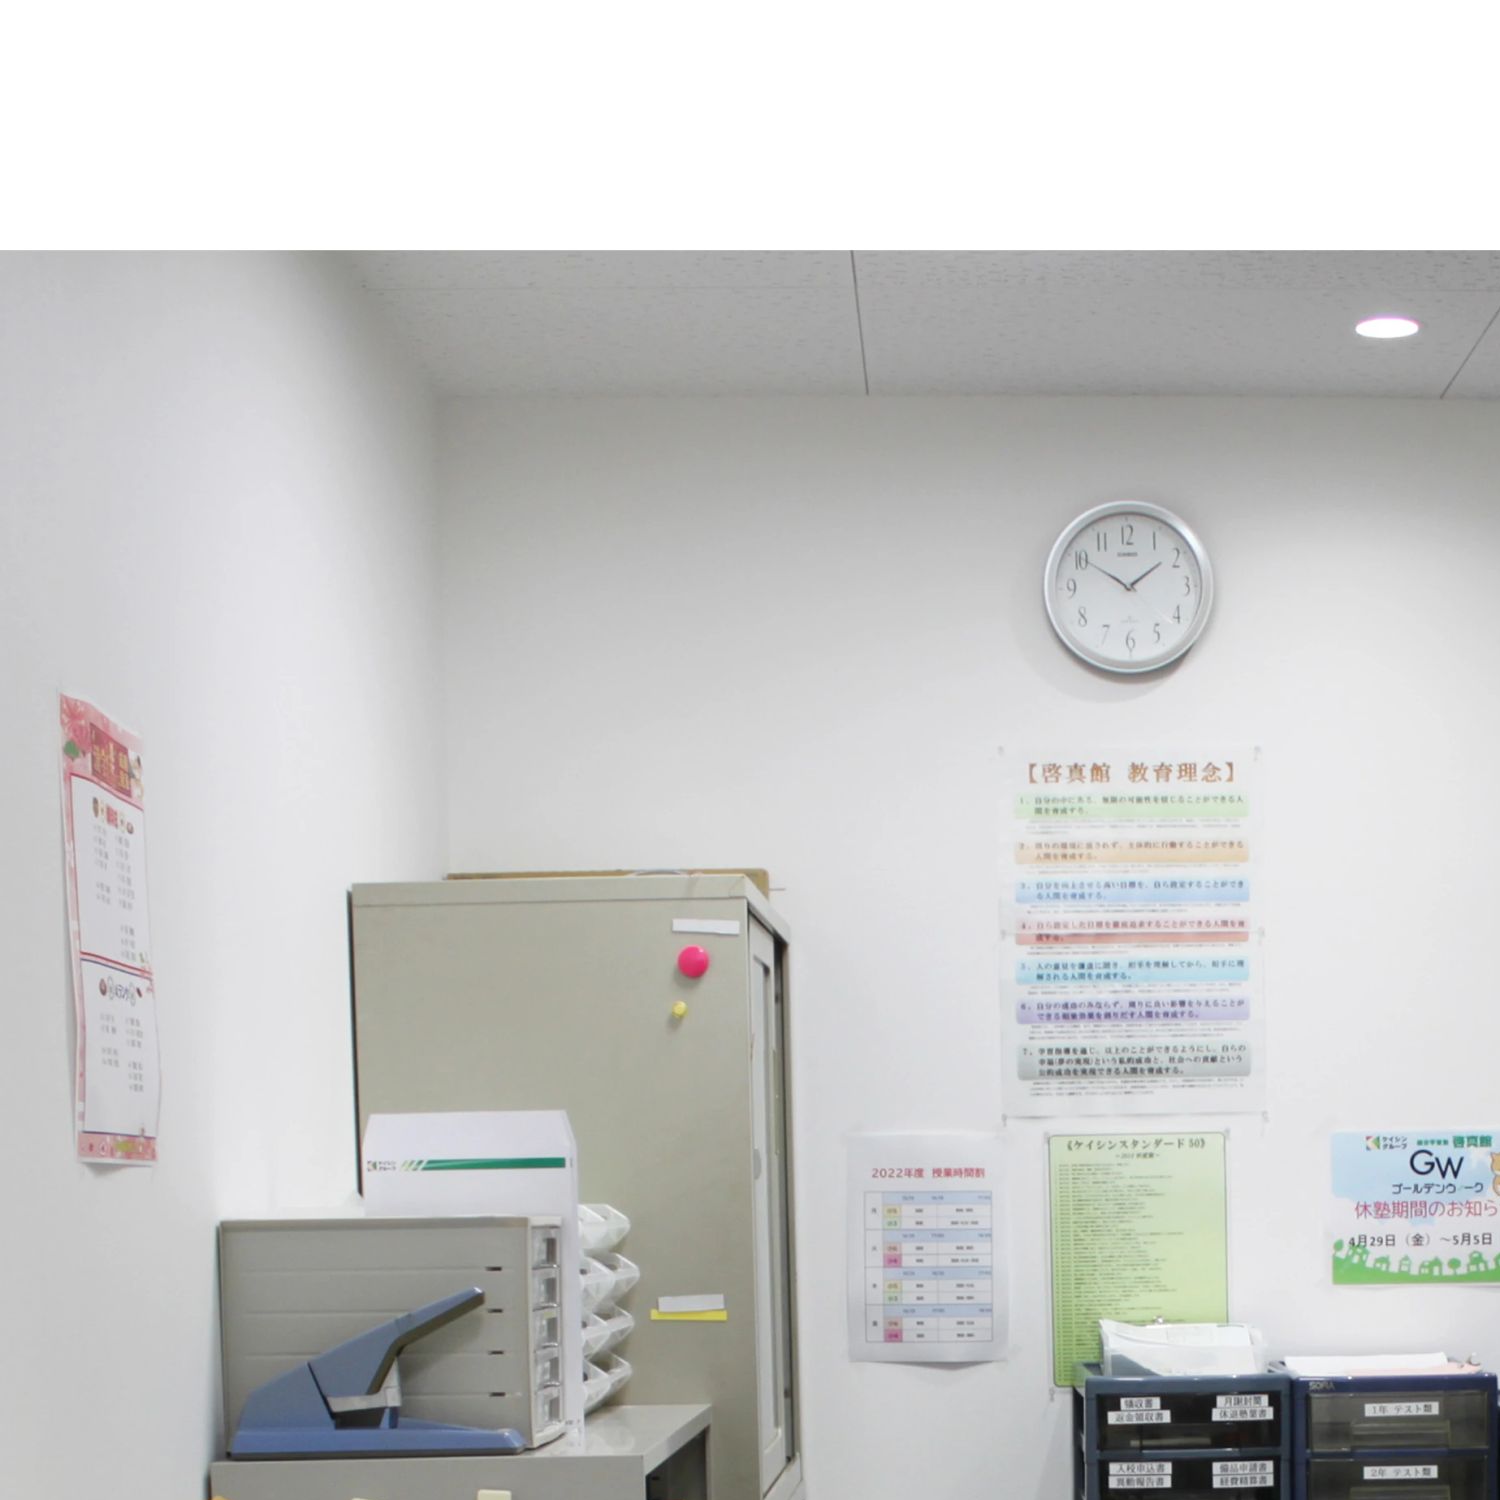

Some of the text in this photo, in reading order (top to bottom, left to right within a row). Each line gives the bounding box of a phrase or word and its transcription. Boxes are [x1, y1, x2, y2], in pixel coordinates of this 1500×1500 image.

[1097, 532, 1107, 551] 11
[1121, 526, 1133, 545] 12
[1152, 532, 1156, 550] 1
[1075, 550, 1088, 570] 10
[1172, 548, 1180, 568] 2
[1066, 579, 1076, 598] 9
[1184, 577, 1190, 596] 3
[1078, 608, 1087, 627] 8
[1173, 606, 1180, 624] 4
[1102, 625, 1110, 645] 7
[1126, 631, 1135, 648] 6
[1153, 624, 1160, 643] 5
[872, 1168, 924, 1179] 2022年度
[1410, 1150, 1463, 1179] GW
[1392, 1183, 1483, 1194] ゴールデンウーク
[1395, 1404, 1433, 1413] テスト類
[1371, 1468, 1432, 1477] 2年 テスト類
